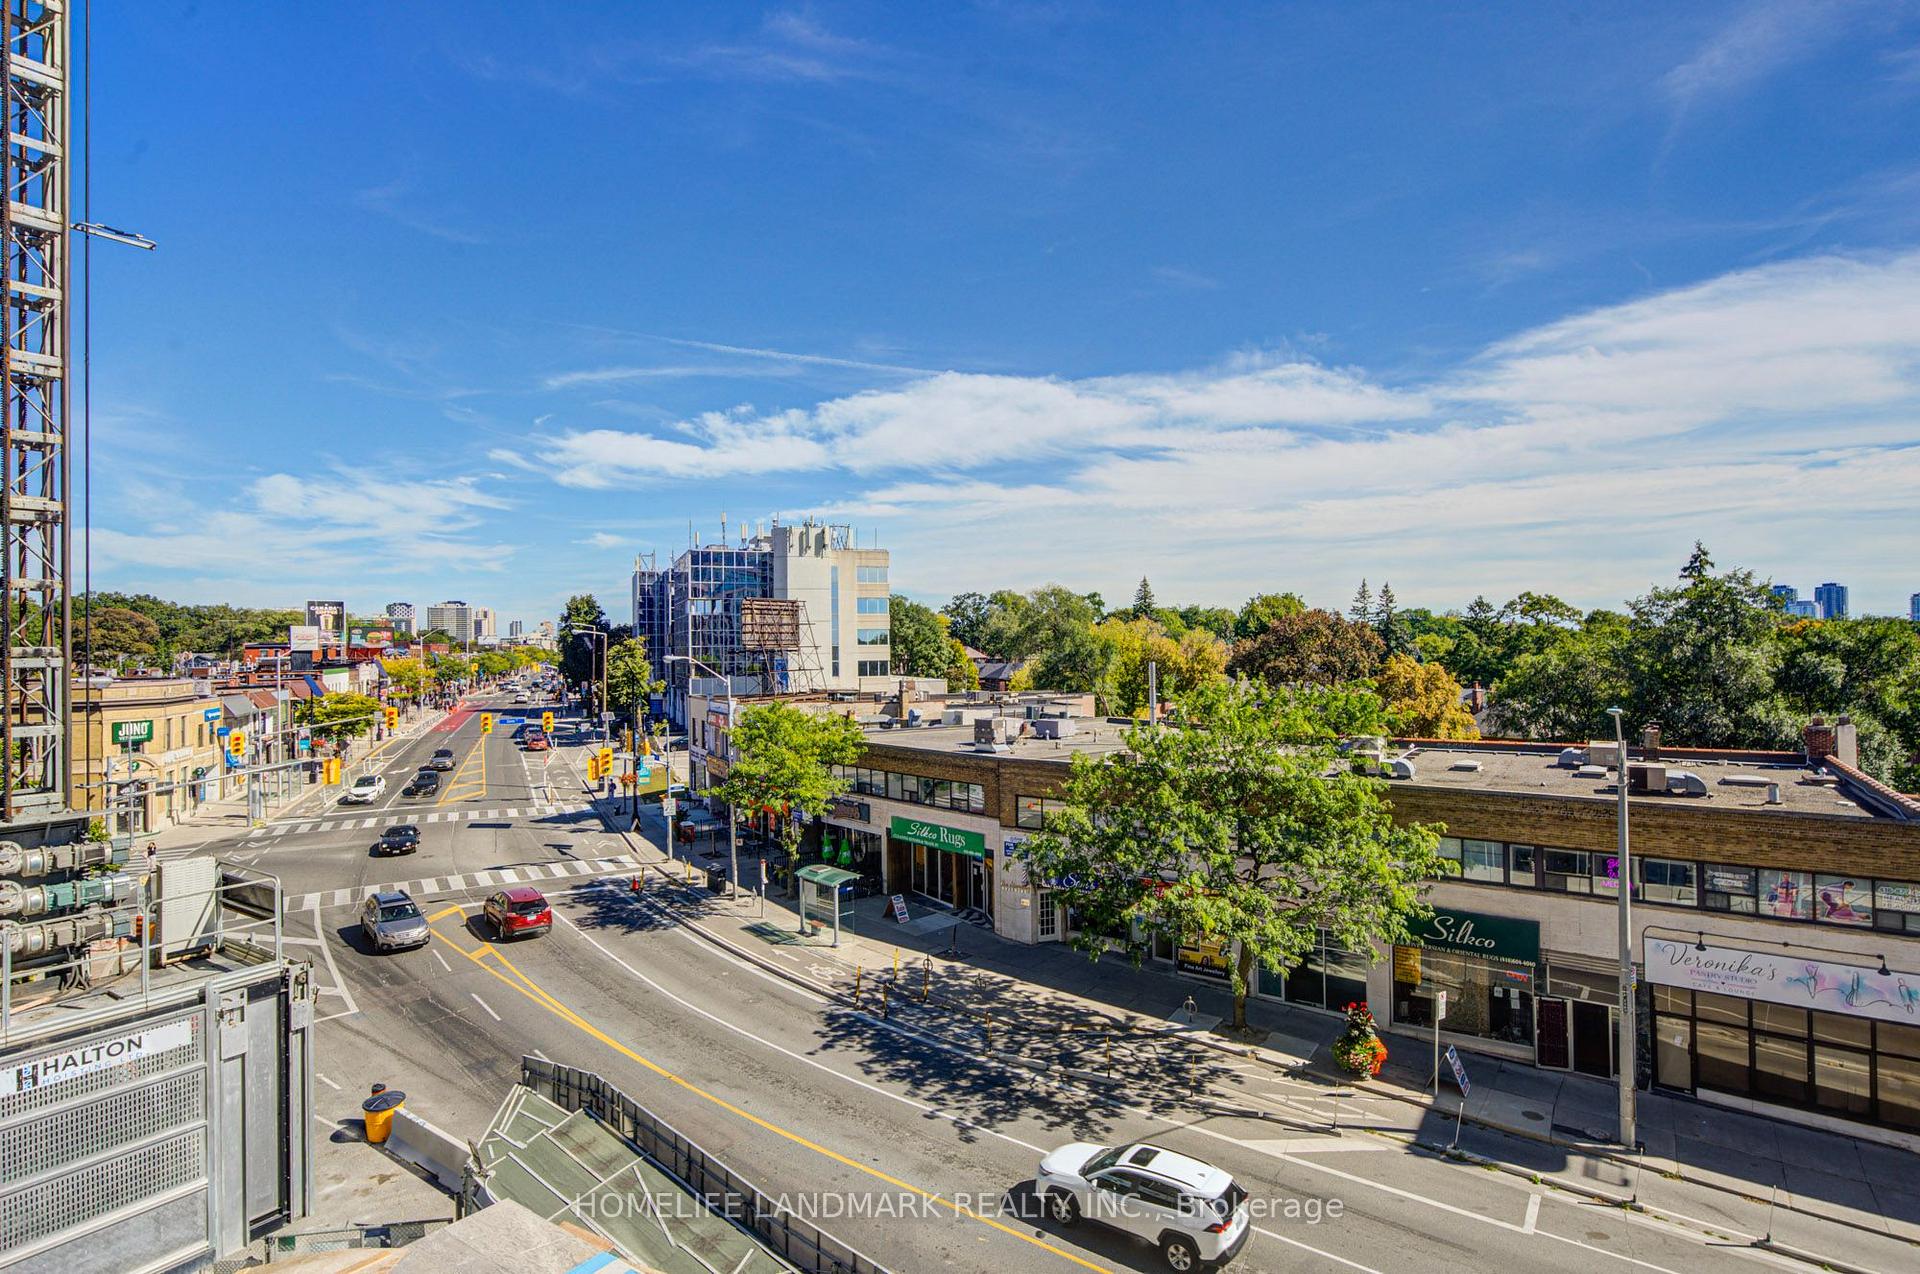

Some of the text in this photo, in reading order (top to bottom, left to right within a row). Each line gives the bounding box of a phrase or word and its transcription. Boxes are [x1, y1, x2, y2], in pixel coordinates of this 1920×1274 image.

[118, 722, 149, 736] JUNO
[907, 822, 938, 840] Silkco
[939, 826, 966, 848] Rugs
[1423, 915, 1496, 949] Silkco
[1661, 943, 1778, 981] Veronika's
[43, 1036, 143, 1076] HALTON
[41, 1061, 111, 1085] HOISTING
